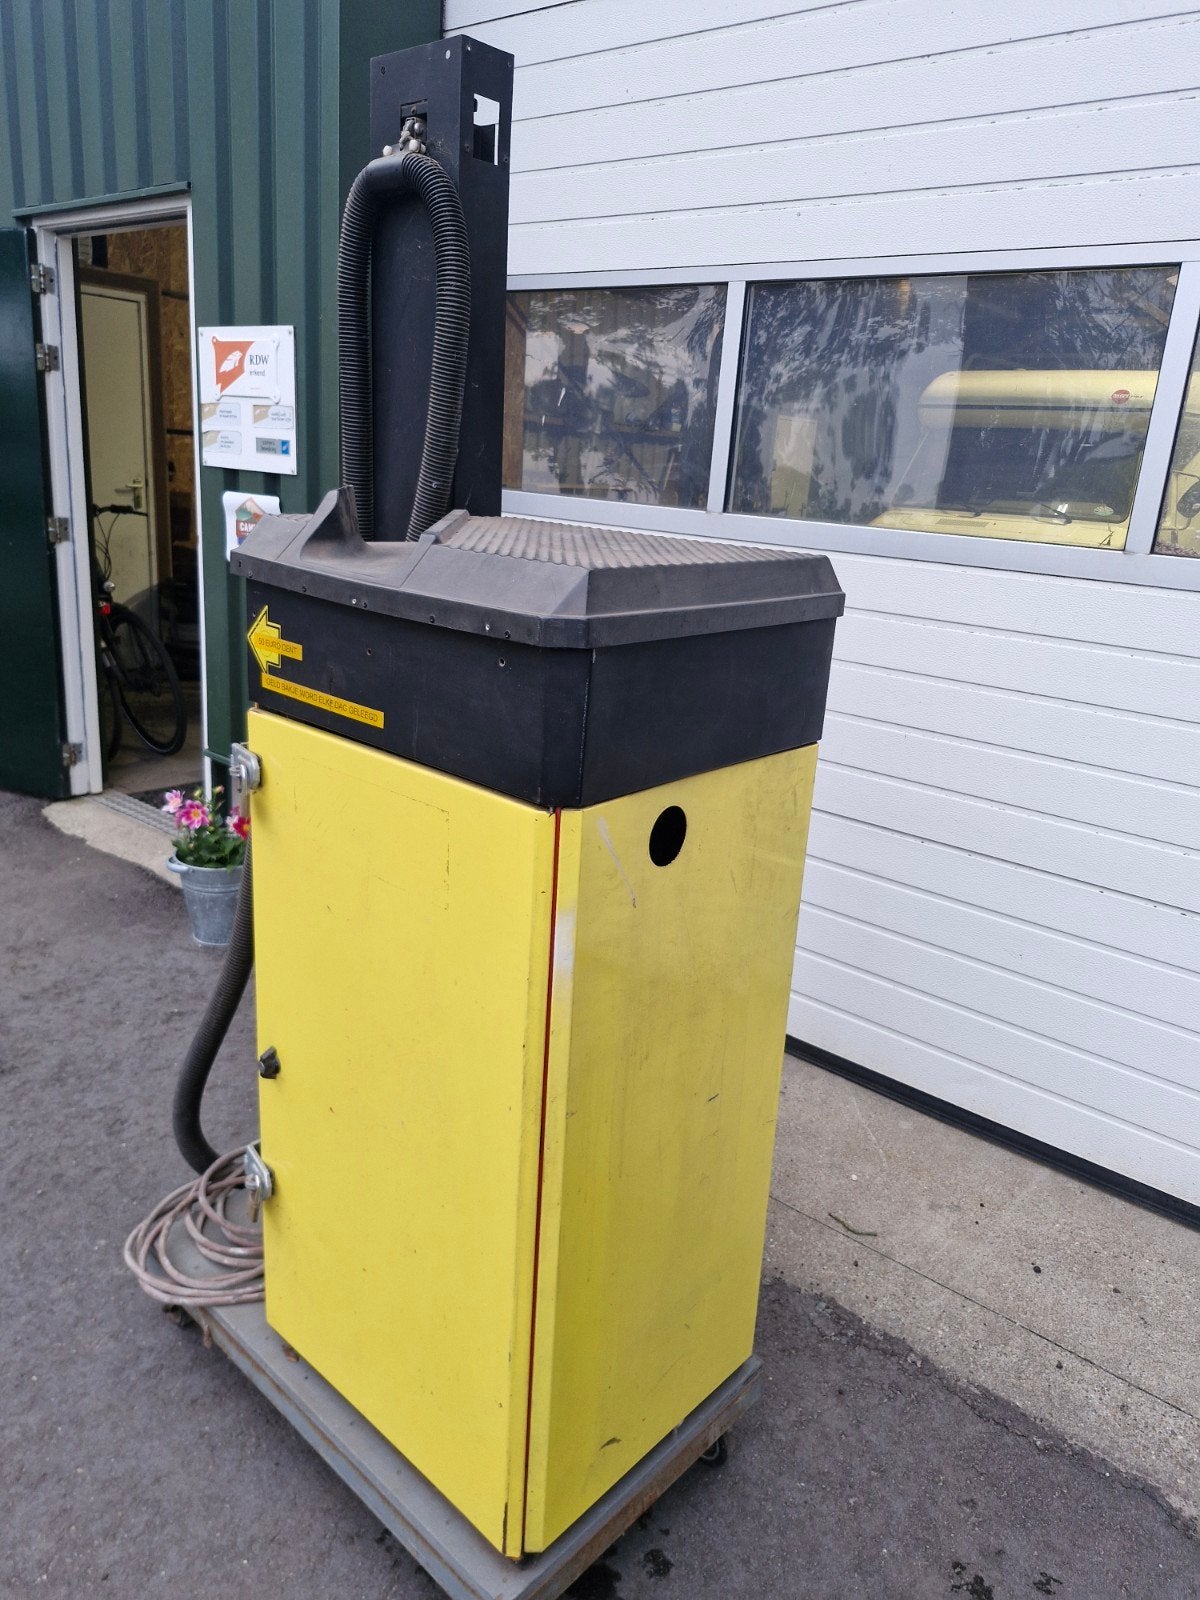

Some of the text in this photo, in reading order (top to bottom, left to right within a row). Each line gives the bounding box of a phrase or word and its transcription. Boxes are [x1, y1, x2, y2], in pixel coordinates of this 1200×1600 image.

[249, 354, 270, 366] RDW
[266, 639, 282, 650] EURO
[282, 643, 298, 653] CENT
[281, 682, 299, 695] BAKJE
[299, 688, 317, 701] WORD
[318, 694, 334, 708] ELKE
[334, 700, 348, 712] DAG
[348, 706, 378, 722] GELEEGD
